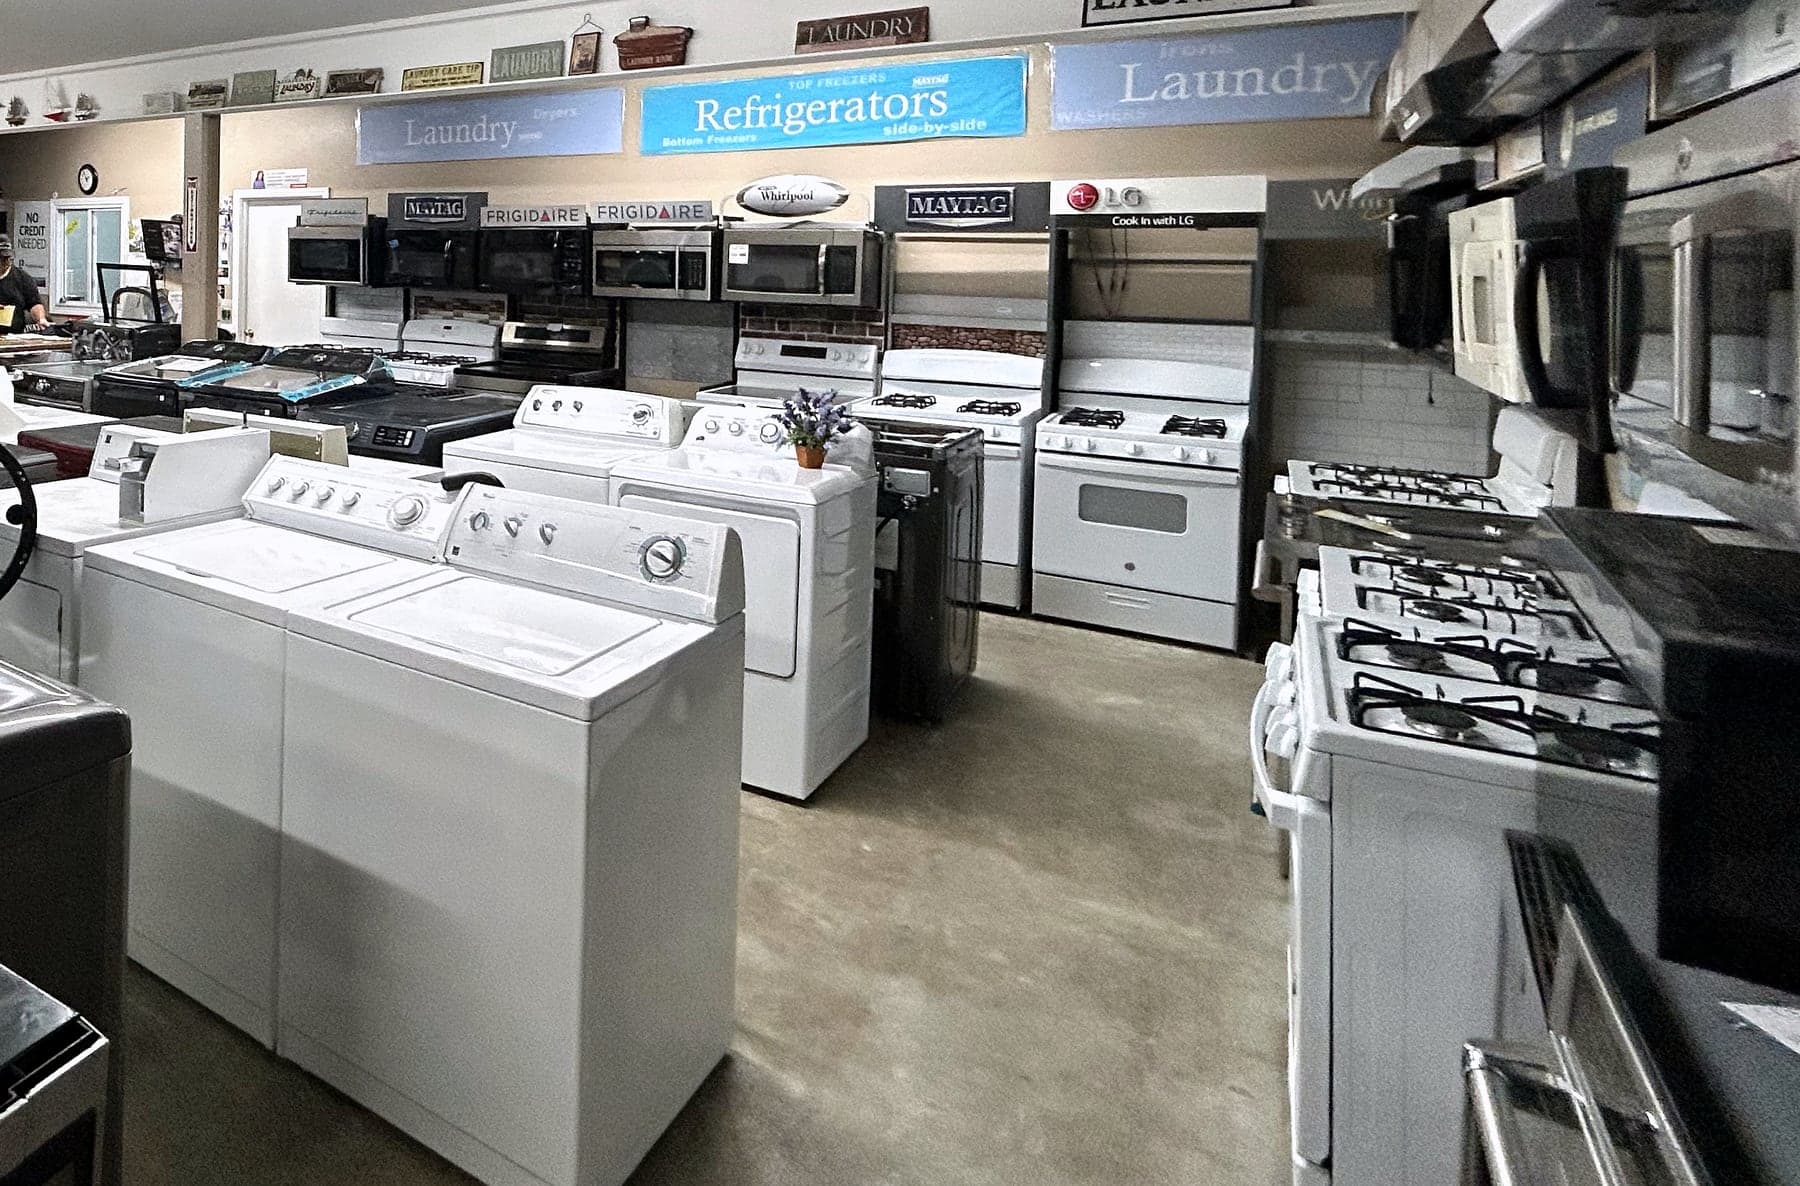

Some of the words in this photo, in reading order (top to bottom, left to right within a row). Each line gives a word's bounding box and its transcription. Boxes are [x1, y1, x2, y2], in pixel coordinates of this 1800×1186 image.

[808, 16, 914, 43] LAUNDRY
[492, 47, 562, 79] LAUNDRY
[788, 79, 813, 90] TOP
[817, 72, 887, 88] FREEZERS
[1119, 52, 1380, 103] Laundry
[694, 88, 949, 134] Refrigerators
[405, 115, 518, 149] Laundry
[882, 119, 988, 136] side-by-side
[662, 136, 704, 147] Bottom
[761, 190, 814, 203] Whirlpool
[1104, 186, 1143, 208] LG
[597, 203, 705, 220] FRIGIDAIRE
[911, 196, 1008, 215] MAYTAG
[26, 212, 39, 223] NO
[486, 208, 580, 223] FRIGIDAIRE
[1112, 216, 1139, 226] Cook
[1153, 215, 1176, 225] with
[1178, 215, 1194, 225] LG
[19, 225, 46, 236] CREDIT
[18, 238, 47, 250] NEEDED
